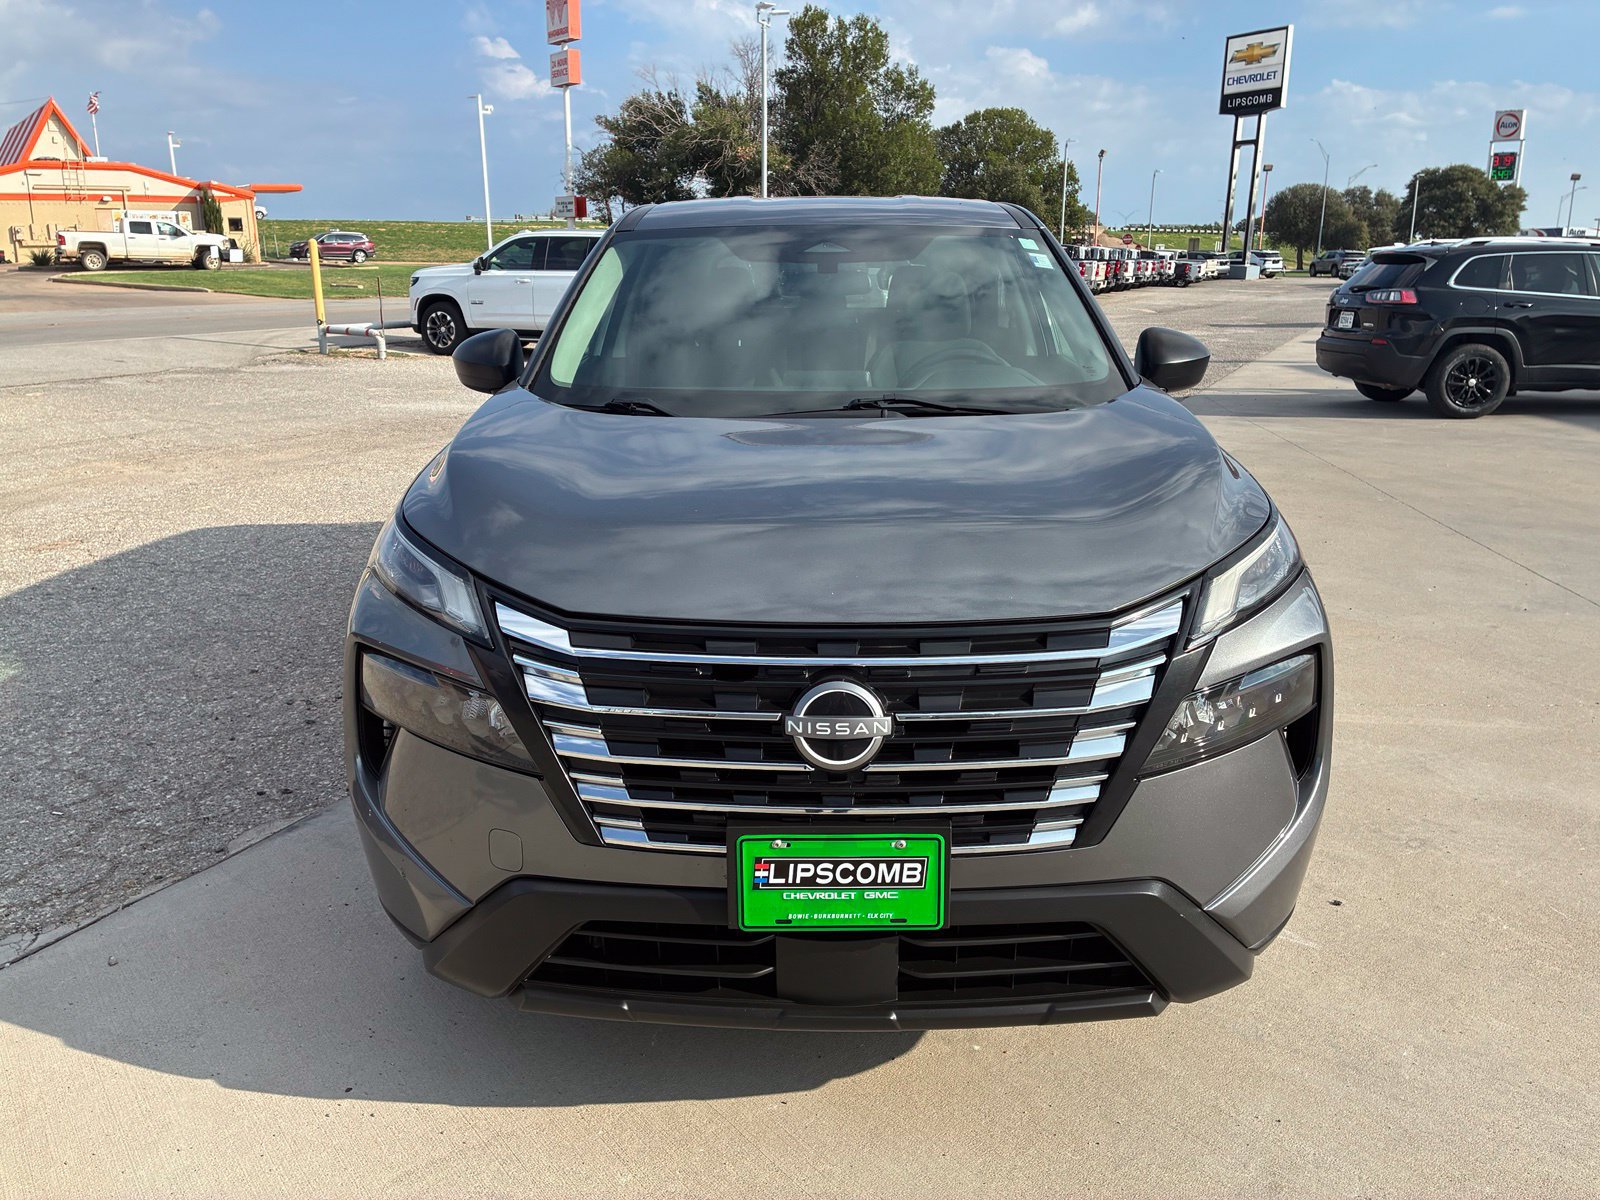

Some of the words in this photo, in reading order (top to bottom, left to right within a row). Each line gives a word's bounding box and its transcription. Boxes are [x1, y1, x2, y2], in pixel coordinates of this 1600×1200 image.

[1226, 70, 1278, 86] CHEVROLET
[1227, 93, 1273, 108] LIPSCOMB
[787, 720, 889, 735] NISSAN
[767, 862, 923, 885] LIPSCOMB
[782, 891, 856, 900] CHEVROLET
[863, 891, 899, 899] GMC
